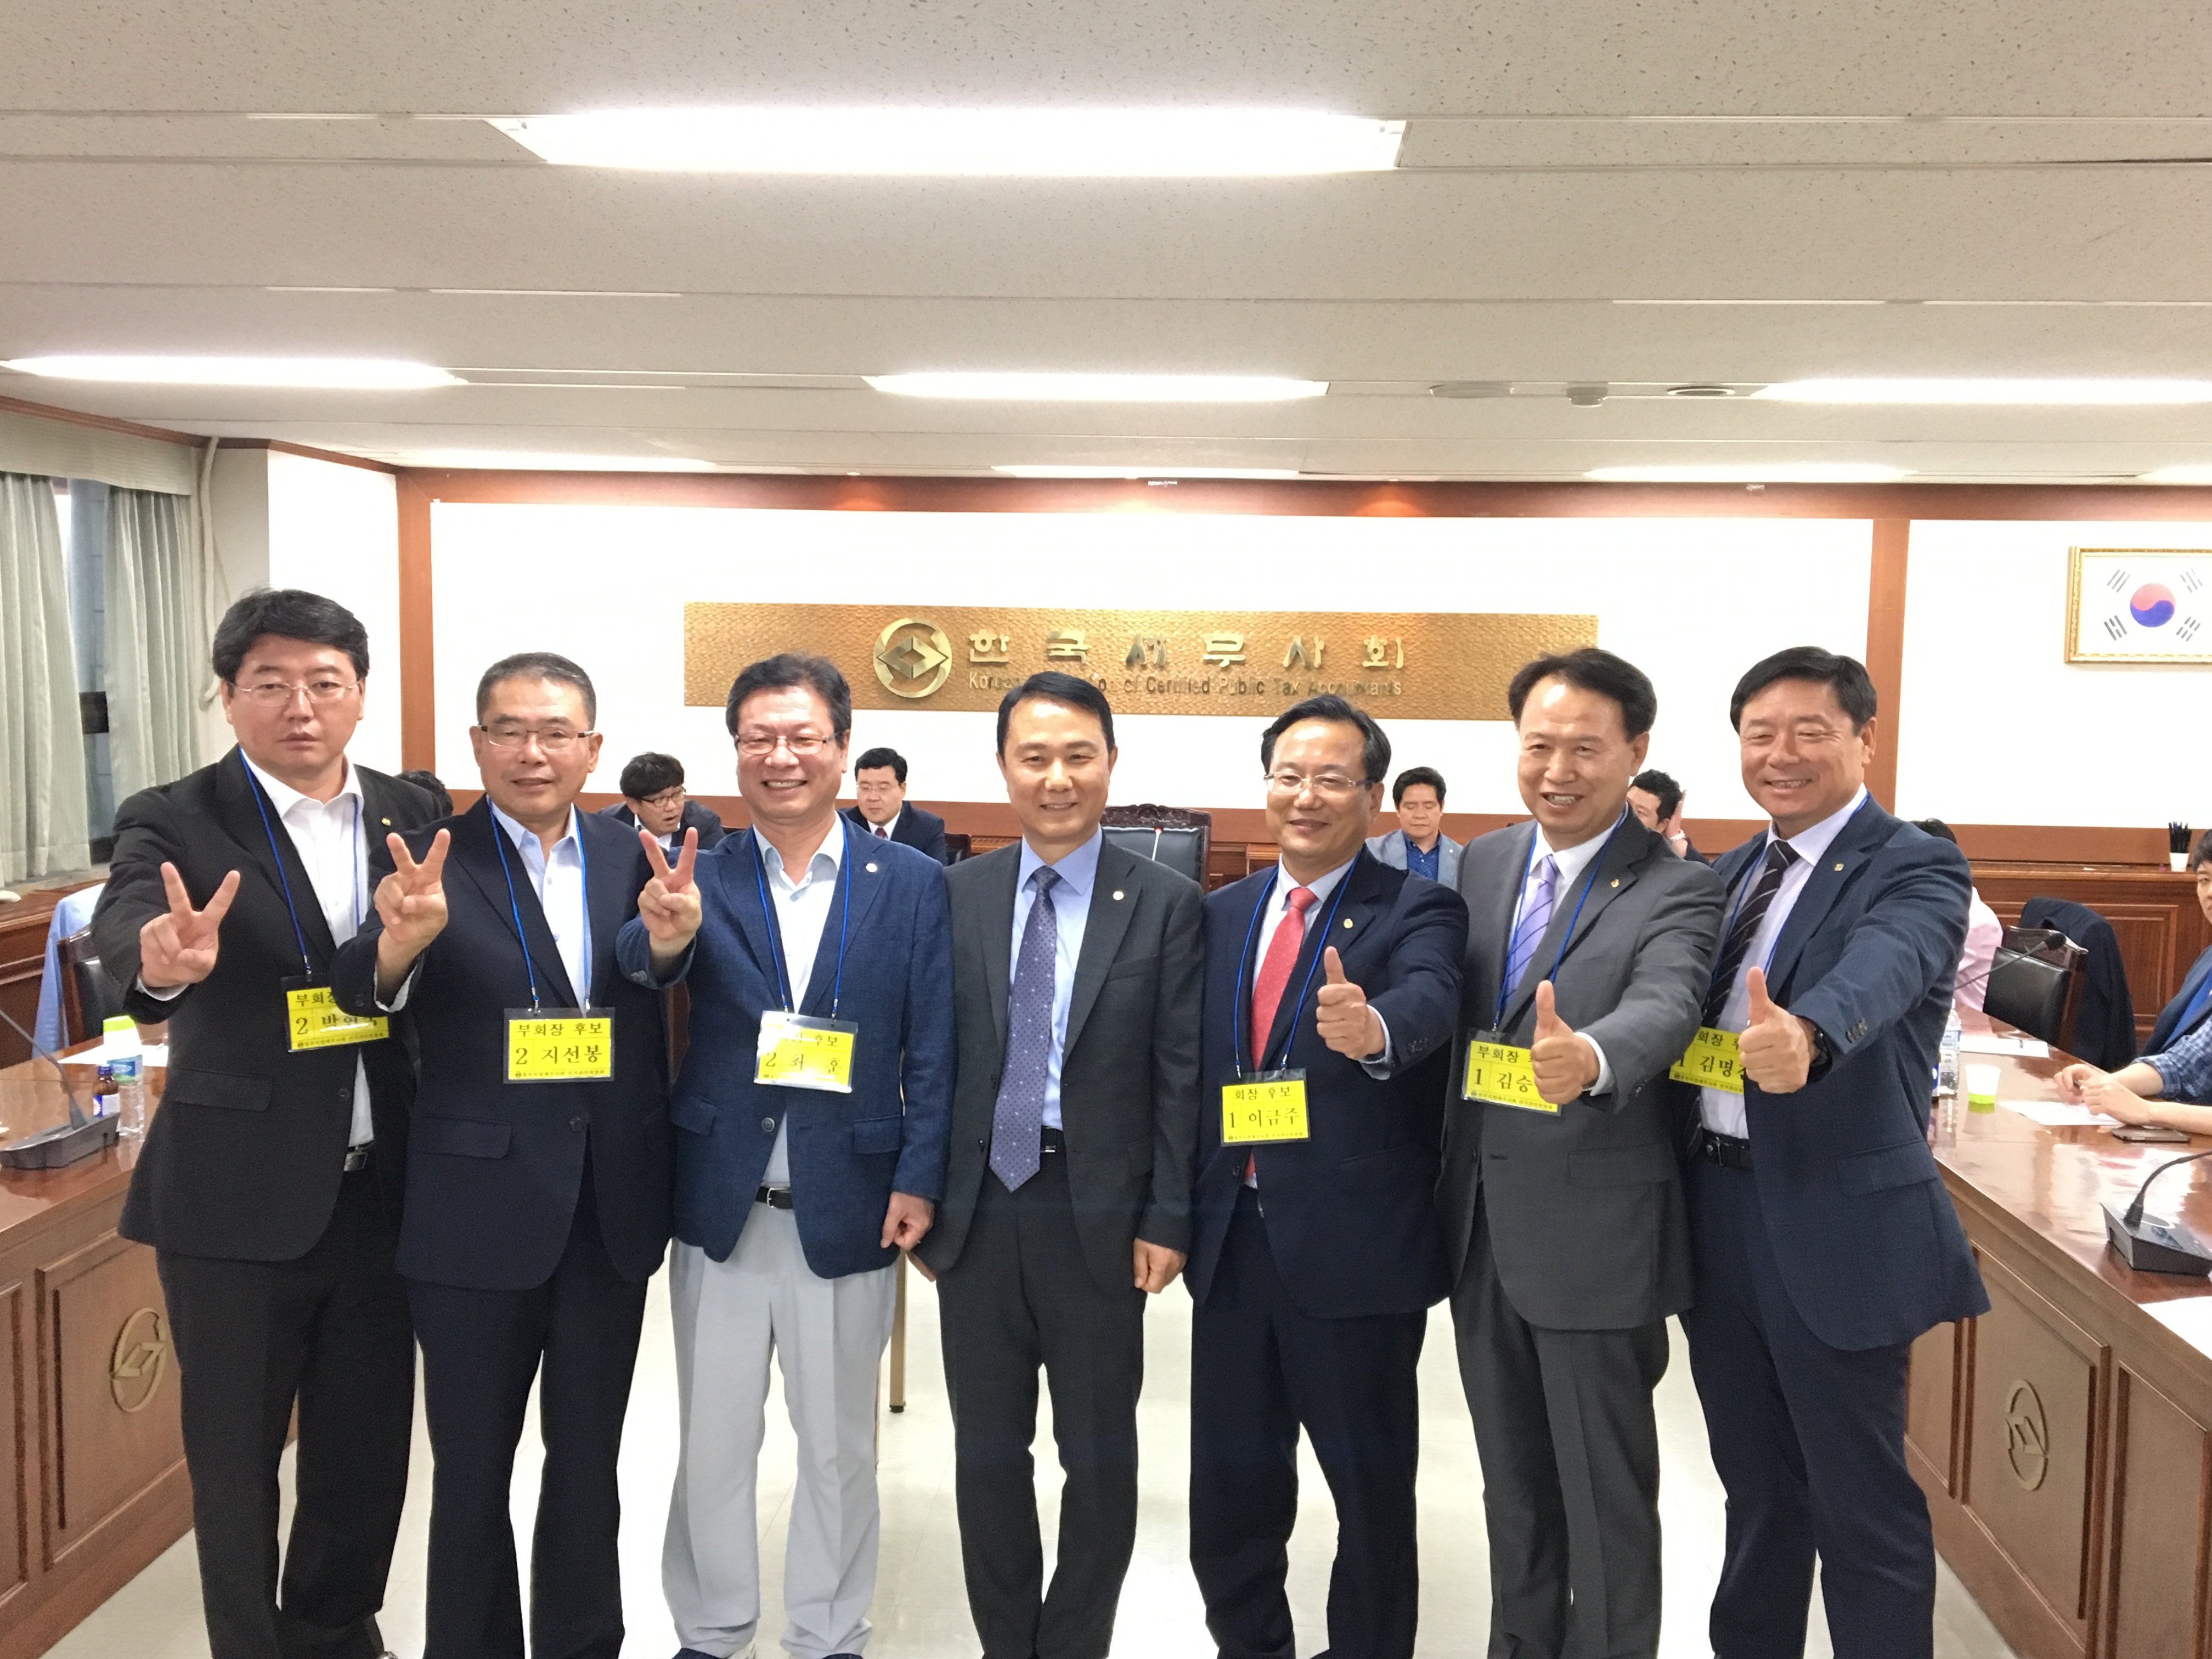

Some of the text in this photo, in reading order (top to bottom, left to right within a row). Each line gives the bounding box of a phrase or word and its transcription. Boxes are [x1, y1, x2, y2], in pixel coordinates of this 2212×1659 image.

[969, 629, 1404, 668] 한국세무사회
[1273, 677, 1300, 696] Tax
[296, 1017, 308, 1035] 2
[517, 1022, 602, 1037] 부회장 후보
[516, 1045, 602, 1065] 2 지선봉
[765, 1052, 777, 1067] 2
[1477, 1045, 1520, 1063] 부회장
[1474, 1068, 1533, 1092] 1 김승
[1234, 1086, 1291, 1101] 회장 후보
[1230, 1108, 1299, 1128] 1 이금주
